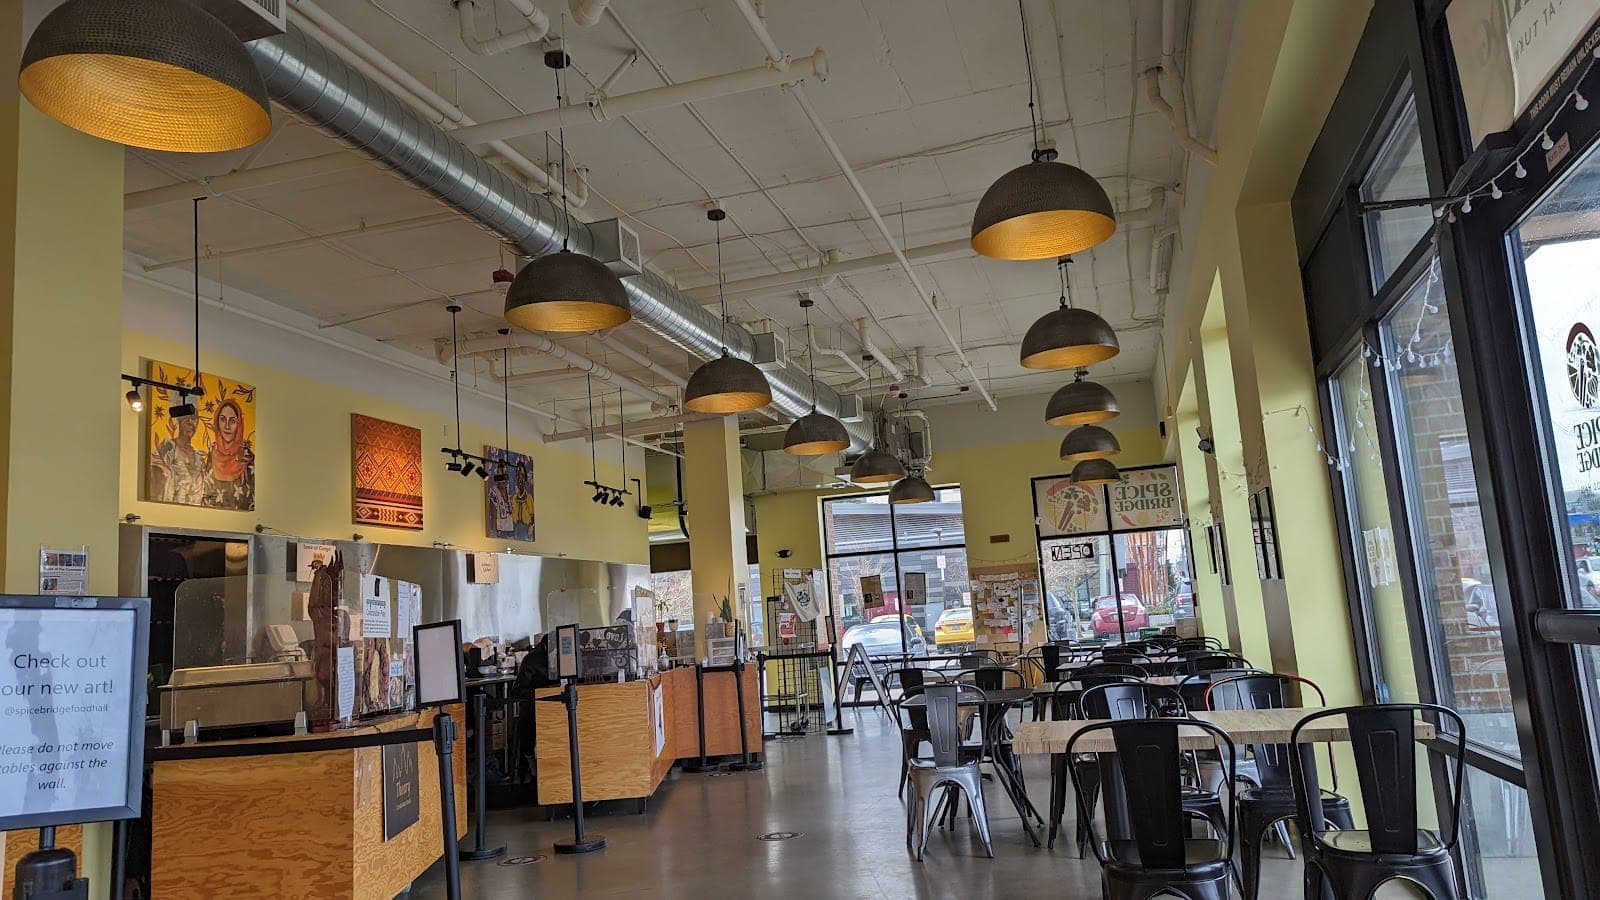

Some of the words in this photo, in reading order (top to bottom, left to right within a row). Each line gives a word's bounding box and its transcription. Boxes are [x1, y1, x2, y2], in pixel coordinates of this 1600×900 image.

[1576, 26, 1600, 65] UNLOCKE
[14, 653, 70, 669] Check
[76, 655, 107, 668] out
[1, 684, 35, 696] our
[40, 683, 79, 695] new
[84, 680, 113, 694] art!
[4, 704, 108, 716] @spicebridgefoodhall
[0, 744, 34, 756] lease
[37, 742, 53, 754] do
[57, 741, 79, 753] not
[81, 741, 114, 752] move
[39, 760, 85, 774] against
[88, 758, 108, 769] the
[38, 778, 66, 791] wall.
